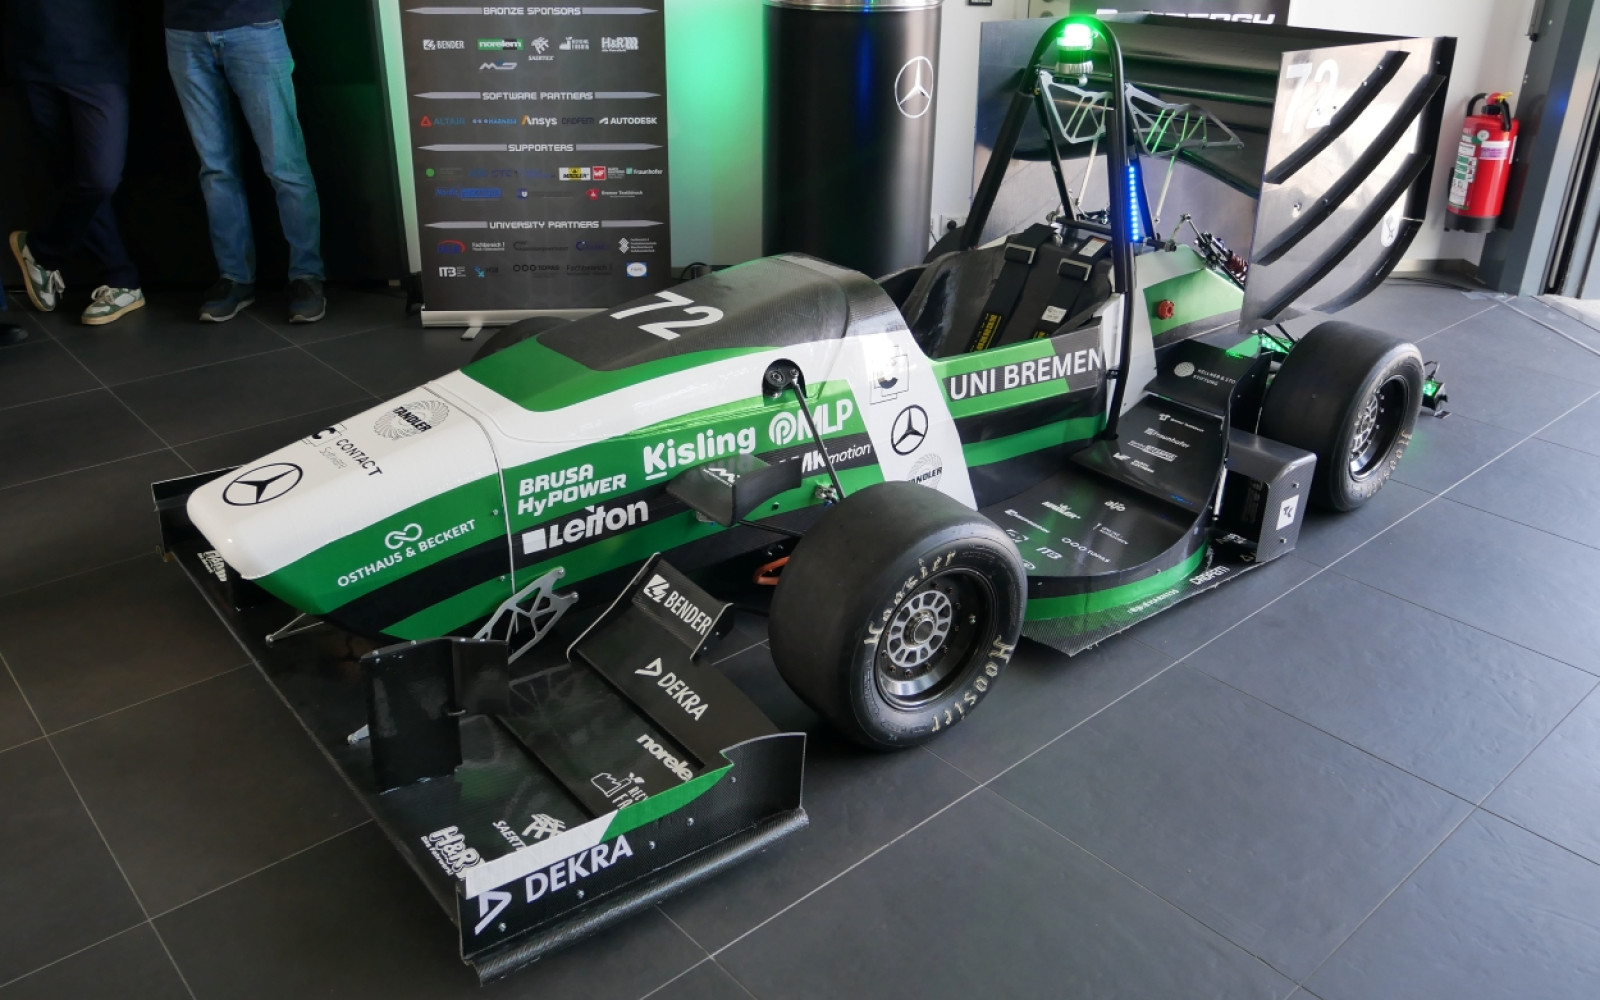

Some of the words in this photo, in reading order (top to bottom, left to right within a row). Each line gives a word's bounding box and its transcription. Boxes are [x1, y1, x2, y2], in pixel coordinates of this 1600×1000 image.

[483, 7, 525, 16] BRONZE
[527, 7, 581, 16] SPONSORS
[437, 40, 465, 50] BENDER
[482, 92, 537, 100] SOFTWARE
[540, 91, 593, 100] PARTNERS
[1282, 58, 1339, 134] 72
[521, 115, 558, 127] Ansys
[610, 117, 658, 125] AUTODESK
[508, 143, 574, 152] SUPPORTERS
[489, 220, 546, 229] UNIVERSITY
[548, 220, 599, 229] PARTNERS
[610, 290, 724, 341] 72
[950, 369, 996, 401] UNI
[1004, 347, 1102, 390] BREMEN
[797, 398, 854, 440] MLP
[336, 438, 383, 476] CONTACT
[643, 426, 756, 477] Kisling
[829, 442, 872, 465] motion
[517, 473, 627, 516] HyPOWER
[519, 463, 594, 497] BRUSA
[908, 466, 943, 485] ANDLER
[337, 552, 403, 587] OSTHAUS
[405, 547, 417, 558] &
[417, 519, 476, 553] BECKERT
[664, 590, 713, 636] BENDER
[657, 672, 709, 722] DEKRA
[636, 733, 694, 783] norele
[428, 825, 481, 873] H&R
[492, 820, 527, 852] SAERT
[525, 834, 633, 903] DEKRA
